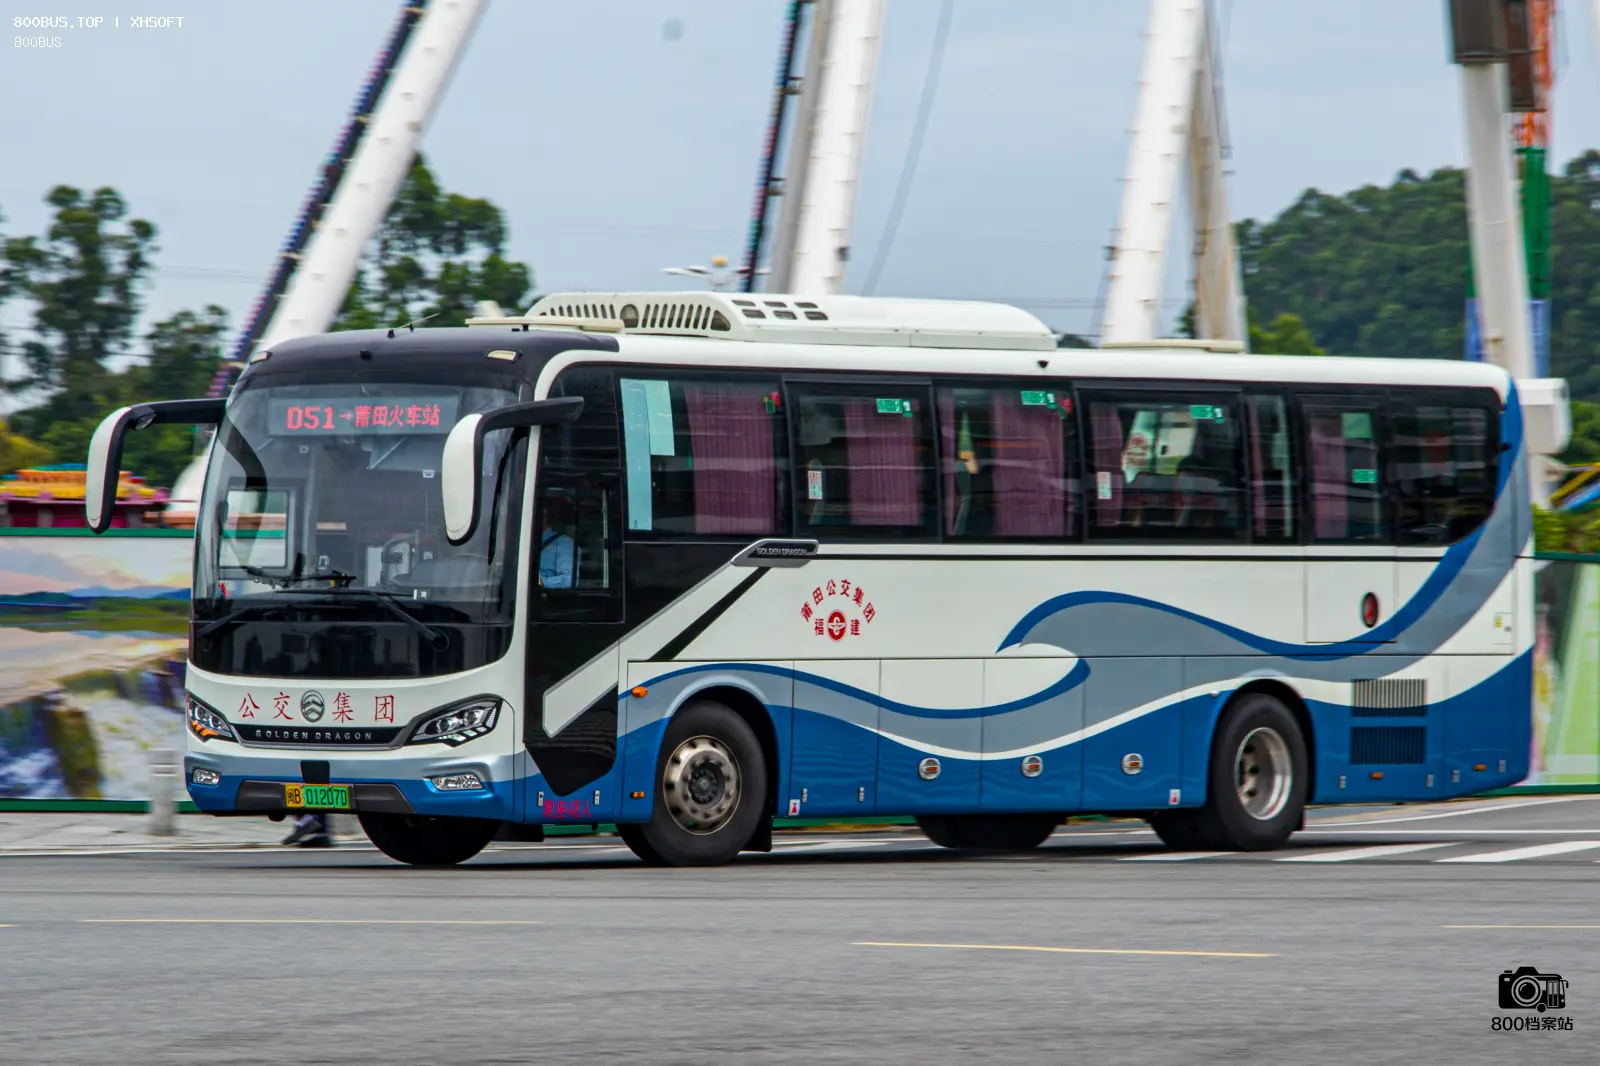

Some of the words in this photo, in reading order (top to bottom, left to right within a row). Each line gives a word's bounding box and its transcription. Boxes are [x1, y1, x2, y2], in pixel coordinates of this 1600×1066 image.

[286, 405, 335, 429] D51
[354, 404, 441, 427] 莆田火车站
[757, 547, 781, 556] GOLDEN
[782, 548, 807, 556] DRAGON
[255, 729, 309, 740] GOLDEN
[315, 731, 372, 740] DRAGON
